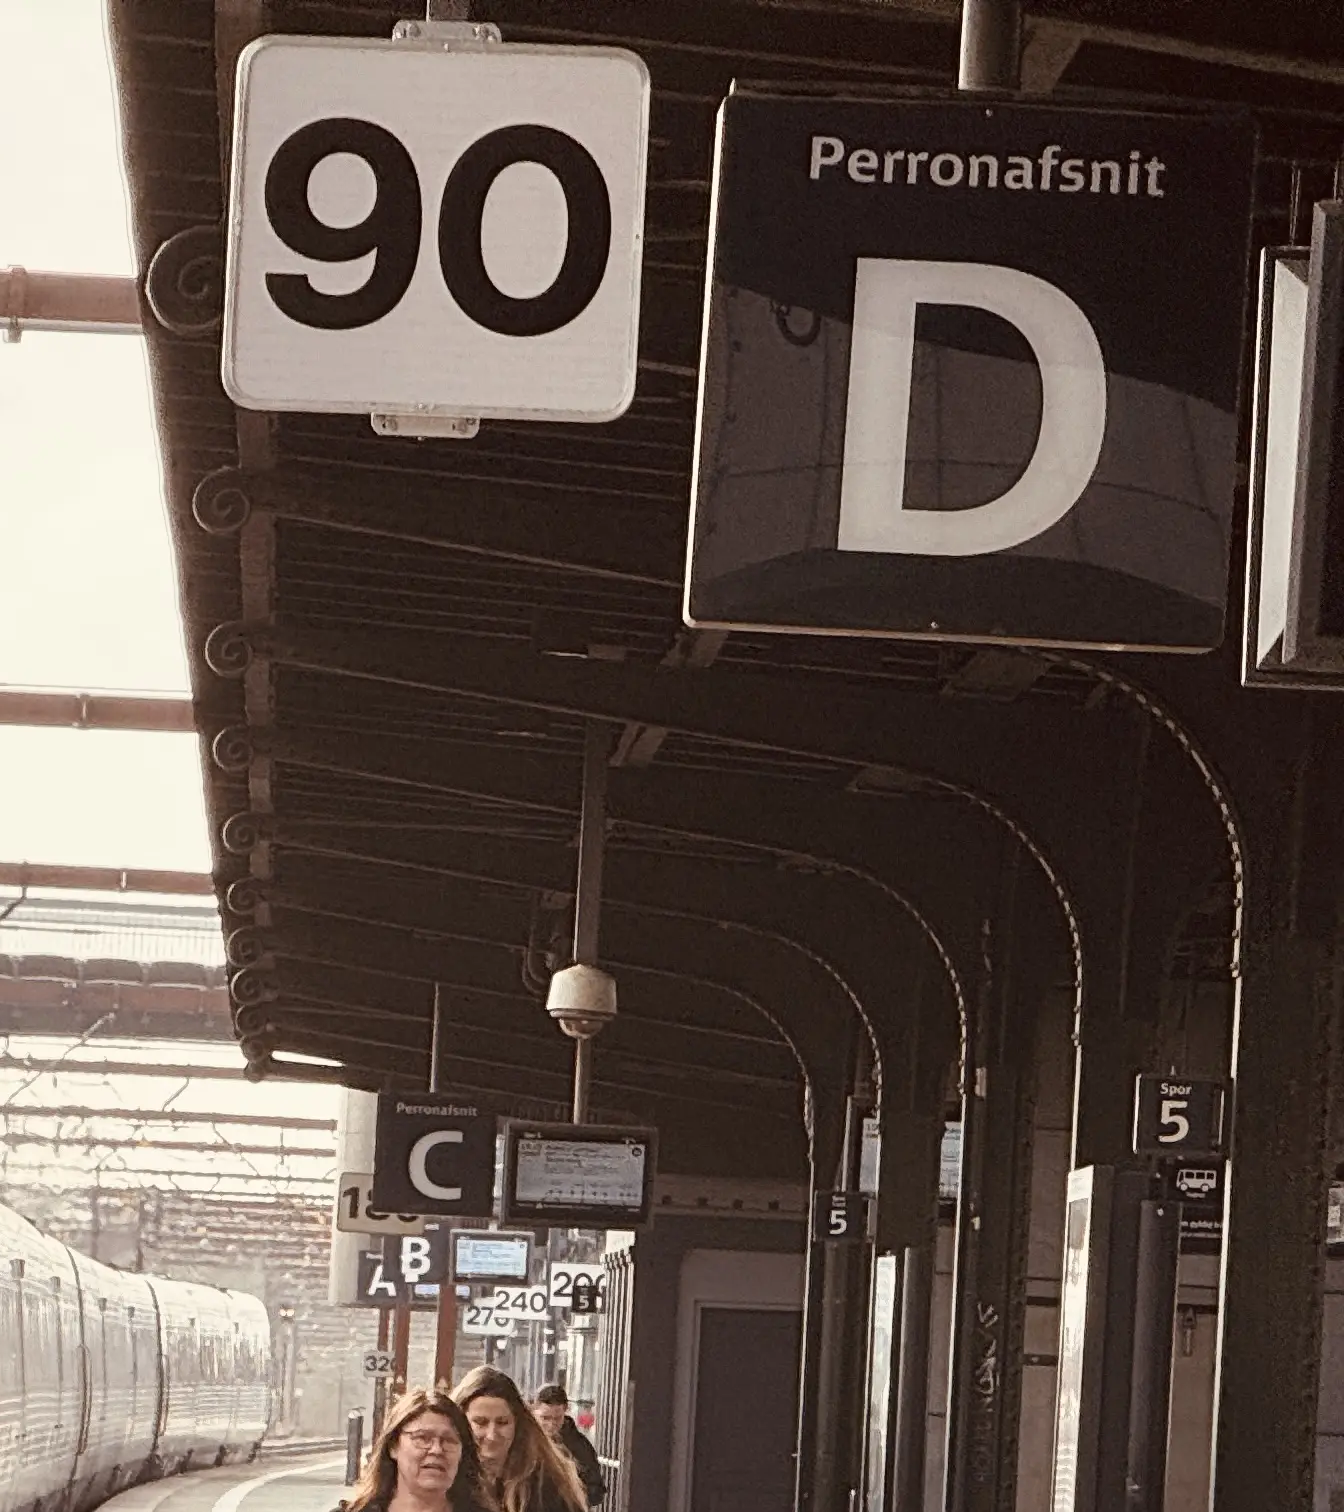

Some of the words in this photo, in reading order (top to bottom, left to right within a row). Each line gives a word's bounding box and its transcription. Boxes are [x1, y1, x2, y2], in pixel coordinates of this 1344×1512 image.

[807, 134, 1167, 199] Perronafsnit
[263, 116, 613, 338] 90
[836, 256, 1108, 558] D
[1159, 1082, 1193, 1096] Spor
[395, 1101, 478, 1117] Perronafsnit
[1157, 1100, 1190, 1143] 5
[408, 1130, 464, 1200] C
[828, 1209, 848, 1235] 5
[401, 1236, 431, 1276] B
[367, 1264, 397, 1297] A
[495, 1290, 547, 1313] 240
[578, 1295, 590, 1310] 5
